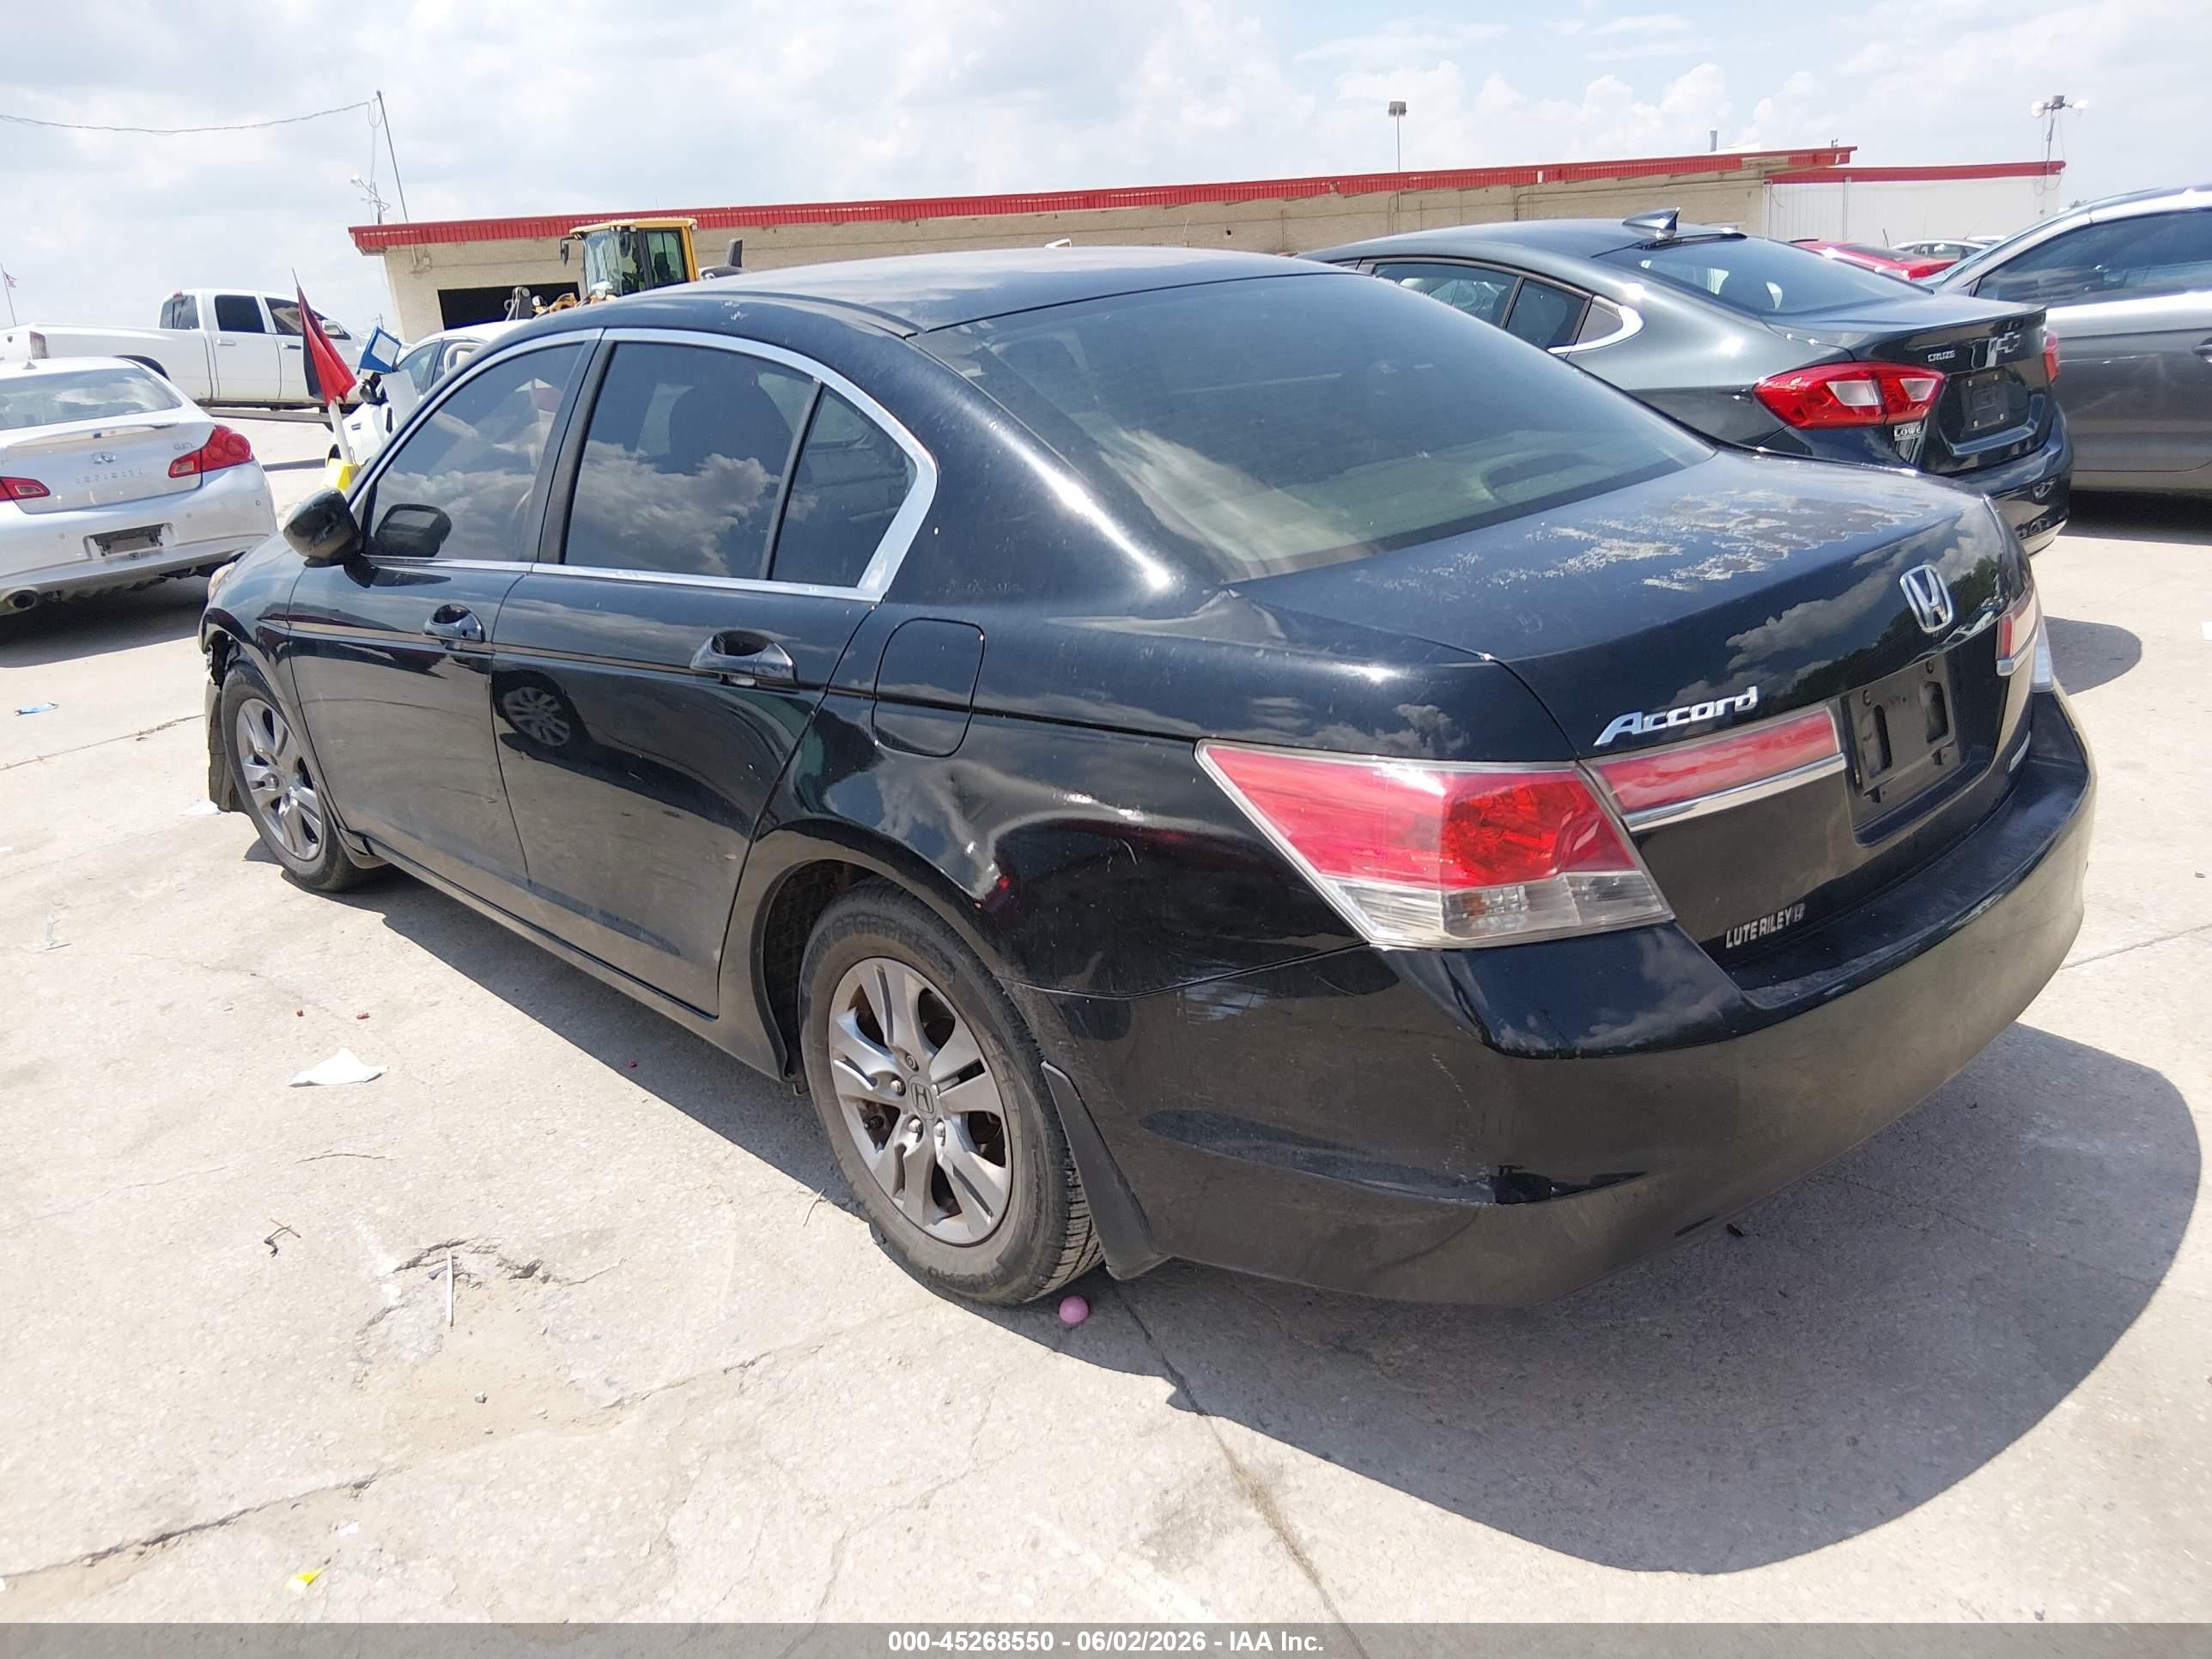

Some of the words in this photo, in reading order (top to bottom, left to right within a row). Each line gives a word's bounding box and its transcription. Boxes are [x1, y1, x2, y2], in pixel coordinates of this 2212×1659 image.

[1927, 350, 1955, 362] CRUZE
[1593, 686, 1759, 747] Accord
[1725, 921, 1758, 949] LUTE
[1759, 906, 1793, 938] RILEY
